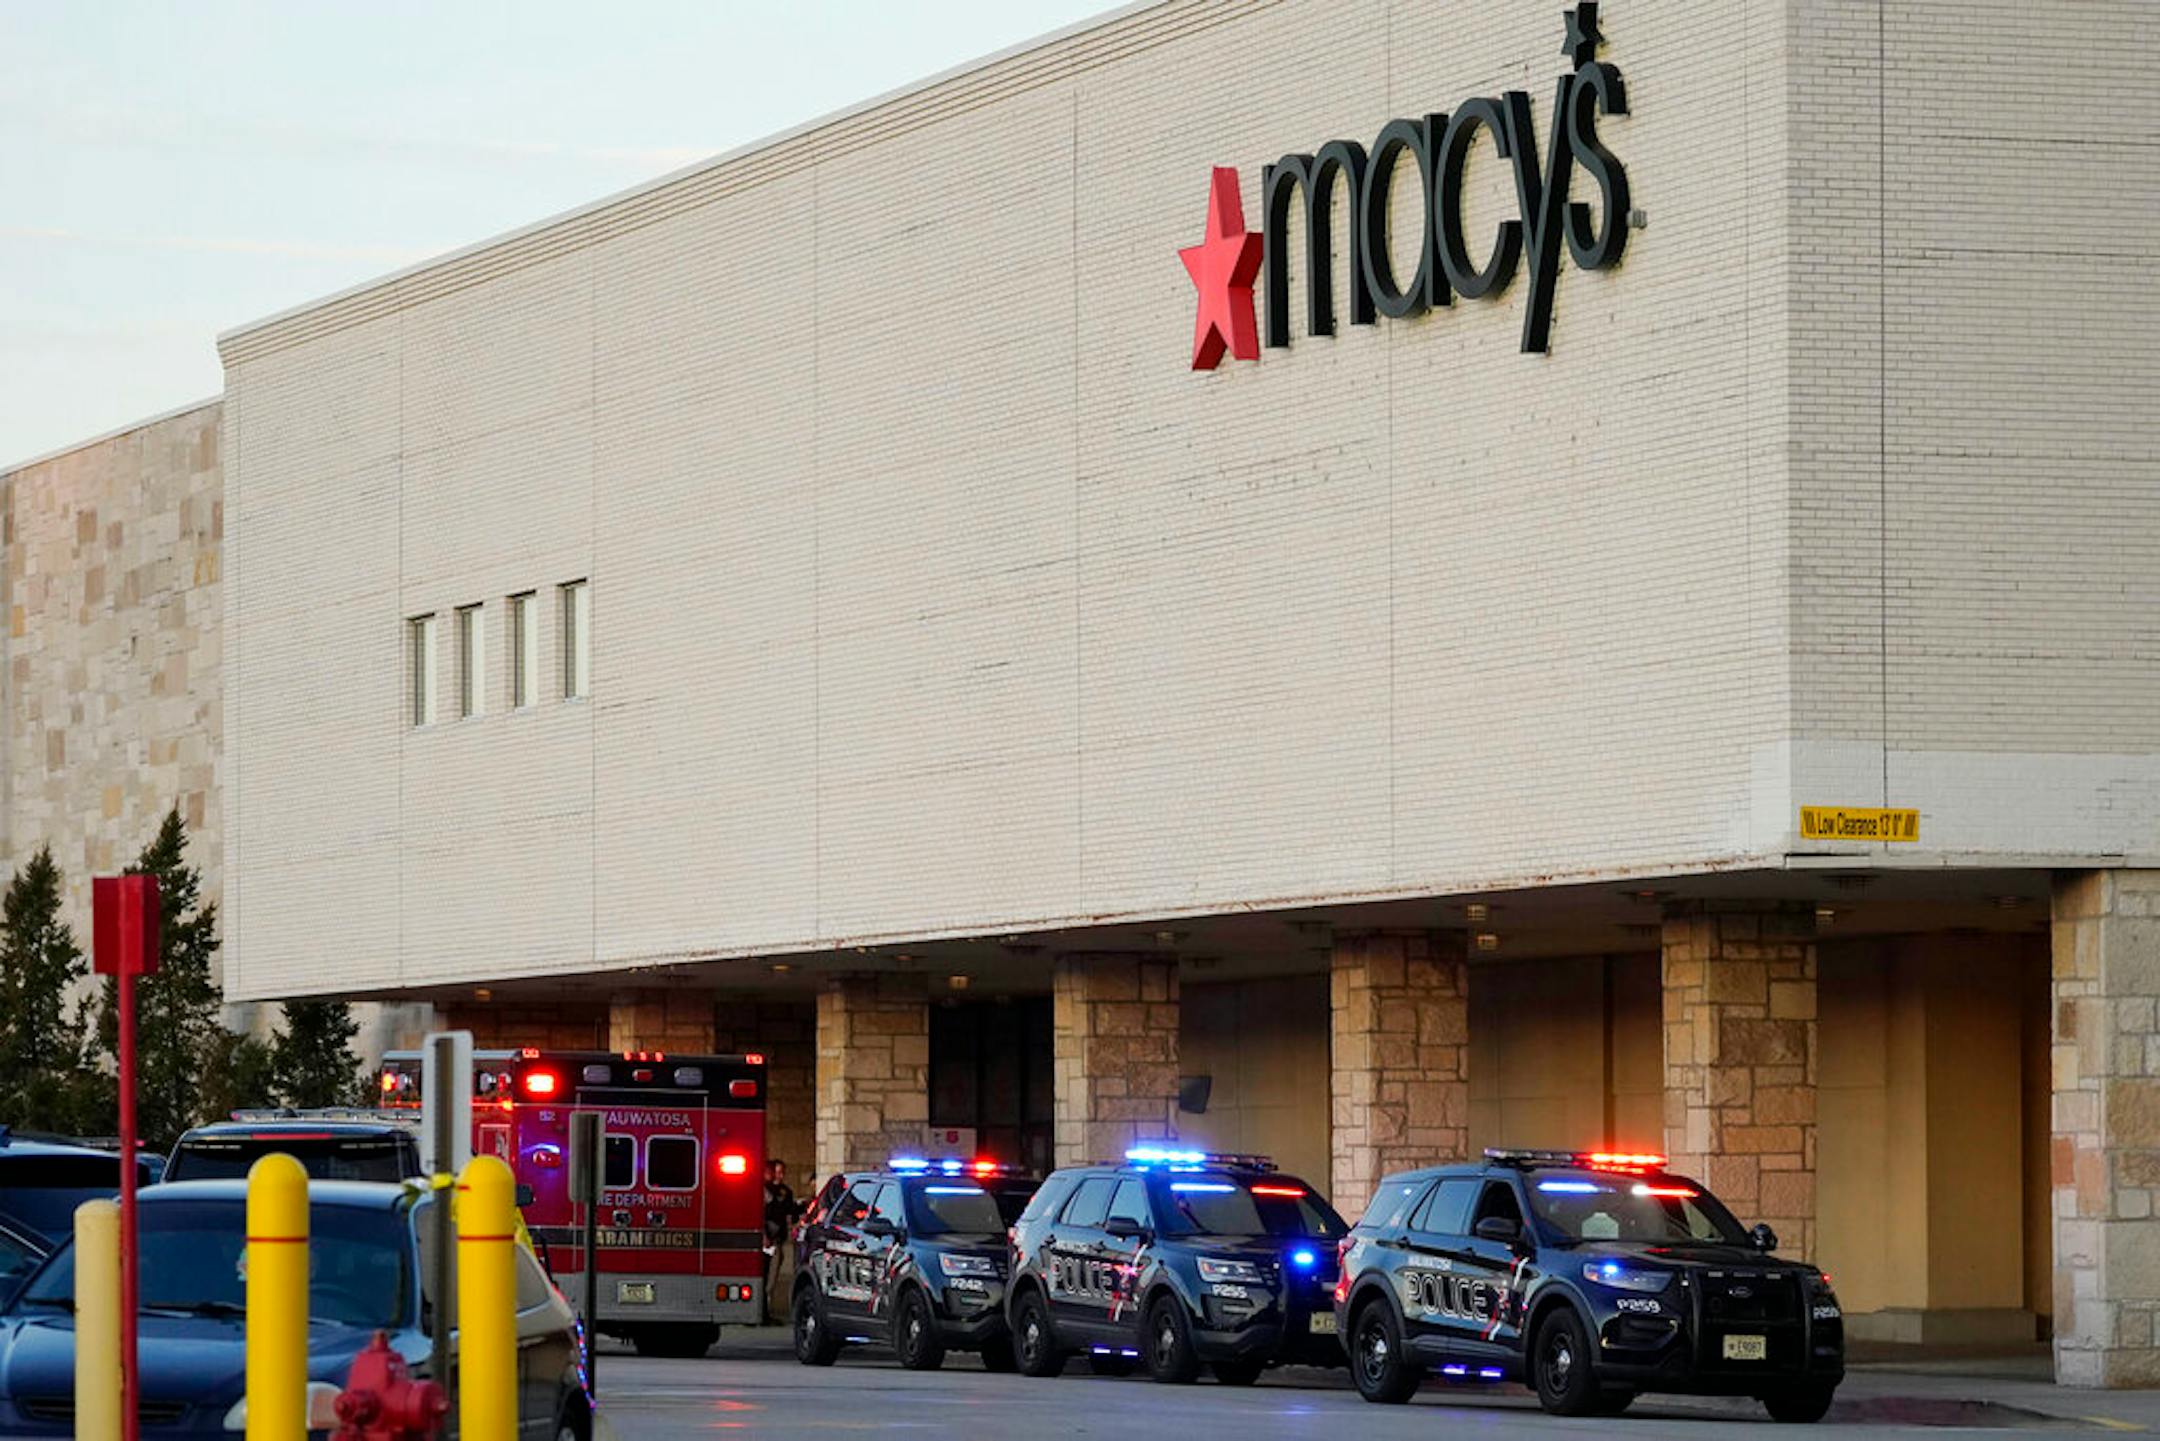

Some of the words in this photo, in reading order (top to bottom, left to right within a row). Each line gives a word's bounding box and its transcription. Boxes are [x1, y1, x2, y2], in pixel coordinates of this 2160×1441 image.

[1262, 2, 1631, 354] macy's
[602, 1111, 691, 1127] AUWATOSA
[615, 1193, 694, 1208] DEPARTMENT
[595, 1230, 694, 1246] ARAMEDICS
[1049, 1255, 1114, 1299] POLICE
[1403, 1271, 1489, 1323] POLICE
